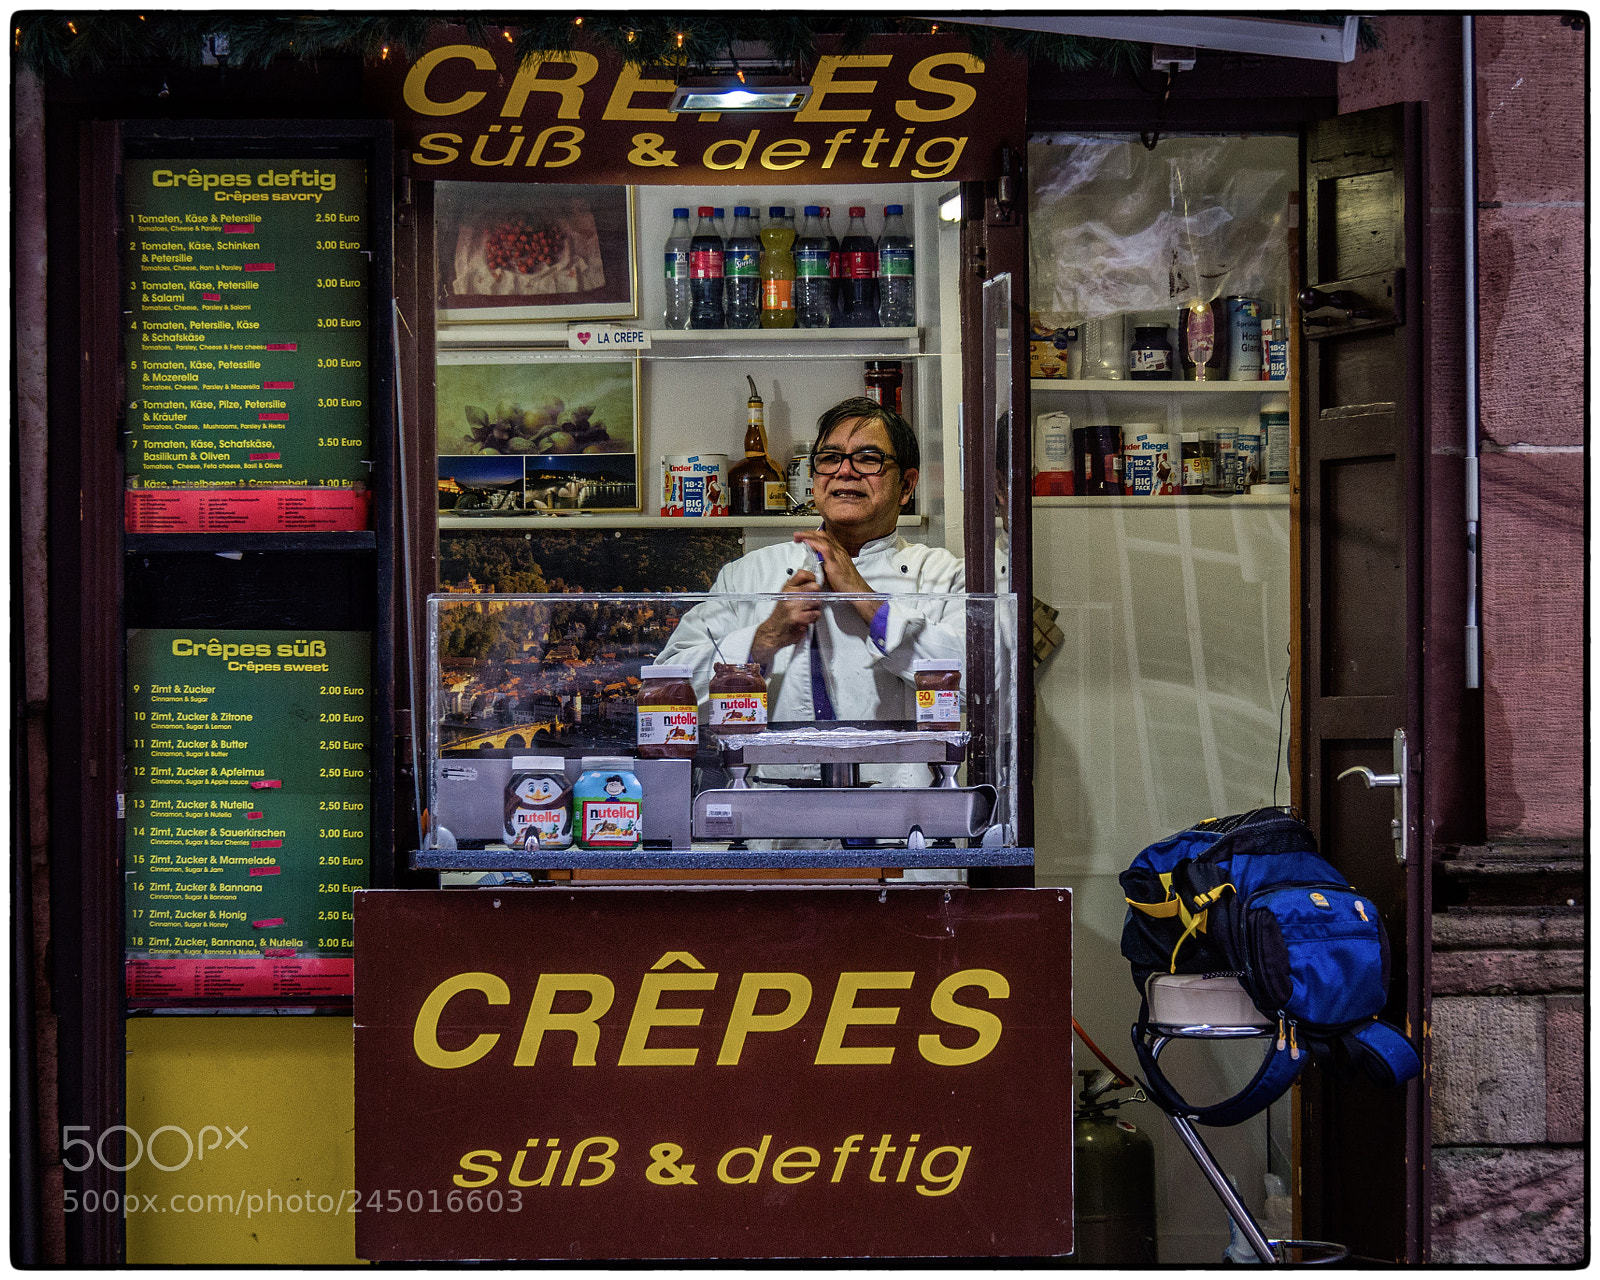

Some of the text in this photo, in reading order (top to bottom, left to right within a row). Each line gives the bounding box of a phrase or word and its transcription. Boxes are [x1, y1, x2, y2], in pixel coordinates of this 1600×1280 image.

[412, 125, 968, 178] süß & deftig
[153, 169, 336, 191] Crêpes deftig
[214, 190, 323, 203] Crêpes savory
[130, 215, 134, 223] 1
[138, 215, 182, 223] Tomaten,
[185, 214, 208, 223] Käse
[211, 214, 218, 223] &
[220, 214, 262, 223] Petersilie
[339, 213, 360, 222] Euro
[130, 242, 136, 250] 2
[141, 242, 186, 251] Tomaten,
[189, 241, 214, 251] Käse,
[217, 241, 260, 250] Schinken
[339, 241, 360, 249] Euro
[142, 254, 193, 262] & Petersilie
[131, 282, 136, 290] 3
[142, 281, 186, 290] Tomaten,
[189, 281, 215, 291] Käse,
[218, 281, 259, 289] Petersilie
[340, 279, 360, 287] Euro
[142, 294, 184, 302] & Salami
[142, 333, 205, 342] & Schafskäse
[597, 328, 644, 344] LA CRÊPE
[131, 361, 137, 369] 5
[142, 361, 187, 370] Tomaten,
[190, 360, 215, 370] Käse,
[218, 360, 261, 369] Petessilie
[341, 359, 361, 367] Euro
[1270, 362, 1285, 371] BIG
[143, 373, 199, 381] & Mozerella
[132, 440, 138, 448] 7
[143, 440, 188, 449] Tomaten,
[191, 440, 216, 449] Käse,
[219, 439, 275, 448] Schafskäse,
[341, 438, 362, 446] Euro
[1142, 442, 1169, 452] Riegel
[144, 452, 230, 461] Basilikum & Oliven
[693, 463, 720, 474] Riegel
[1135, 477, 1151, 485] BIG
[685, 499, 702, 507] BIG
[172, 638, 326, 660] Crêpes süß
[228, 661, 328, 673] Crêpes sweet
[134, 685, 140, 693] 9
[151, 685, 172, 693] Zimt
[174, 685, 181, 693] &
[184, 685, 215, 693] Zucker
[343, 686, 364, 695] Euro
[918, 691, 931, 701] 50
[720, 698, 758, 709] nutella
[134, 712, 146, 720] 10
[151, 712, 174, 722] Zimt,
[177, 712, 209, 721] Zucker
[211, 713, 218, 721] &
[220, 713, 253, 721] Zitrone
[343, 714, 364, 722] Euro
[663, 712, 697, 725] nutella
[134, 767, 145, 775] 12
[151, 767, 174, 777] Zimt,
[176, 767, 208, 776] Zucker
[211, 767, 218, 776] &
[220, 768, 264, 777] Apfelmus
[343, 768, 364, 777] Euro
[517, 811, 561, 823] nutella
[590, 806, 635, 819] nutella
[134, 827, 145, 835] 14
[150, 828, 173, 837] Zimt,
[176, 828, 208, 836] Zucker
[210, 828, 217, 836] &
[220, 828, 285, 837] Sauerkirschen
[343, 829, 363, 838] Euro
[413, 951, 1011, 1069] CRÊPES
[453, 1134, 972, 1197] süß & deftig
